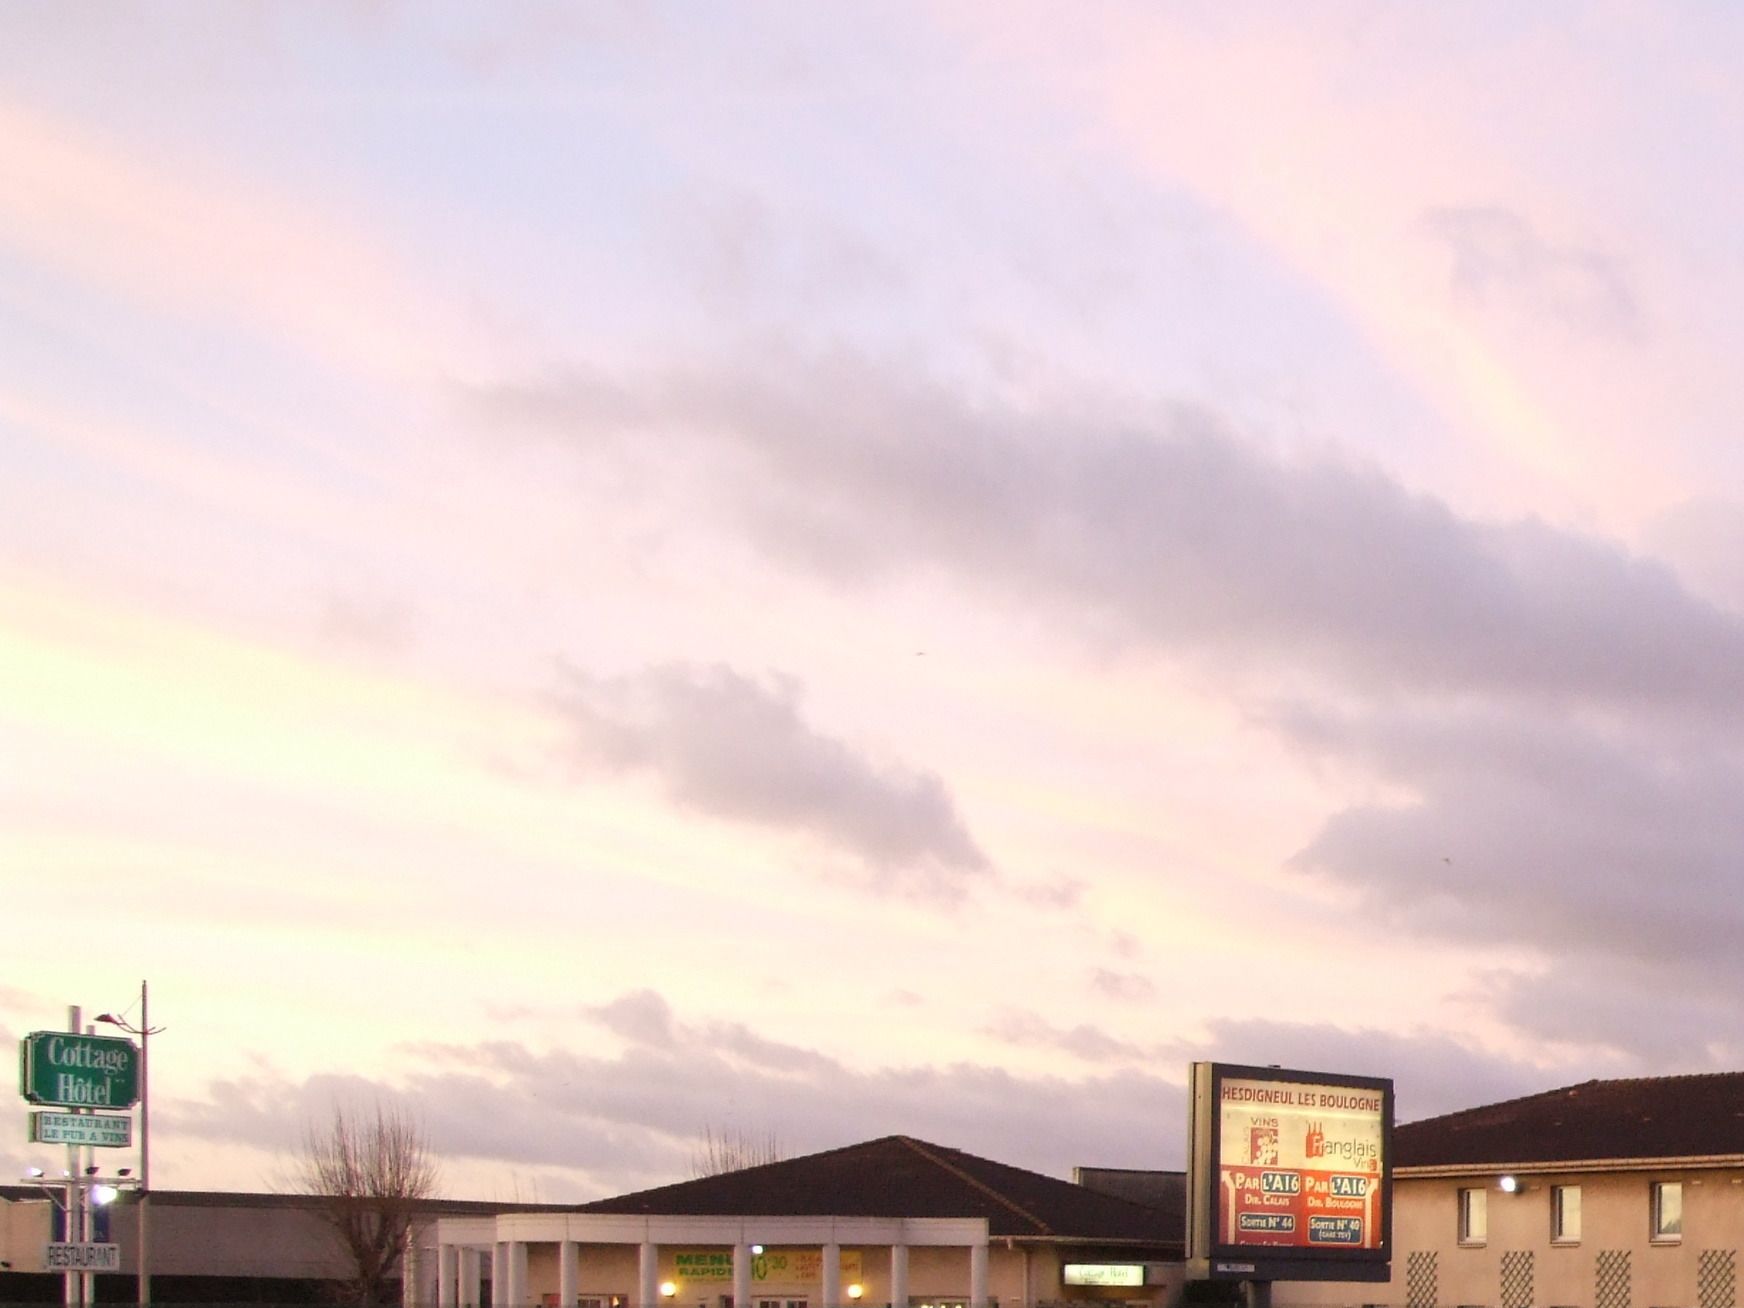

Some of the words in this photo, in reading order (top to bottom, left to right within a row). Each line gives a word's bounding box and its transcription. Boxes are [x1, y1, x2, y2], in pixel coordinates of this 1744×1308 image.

[48, 1037, 128, 1076] Cottage
[58, 1073, 112, 1105] Hôtel
[1222, 1087, 1294, 1105] HESDIGNEUL
[1298, 1094, 1316, 1106] LES
[1320, 1094, 1380, 1112] BOULOGNE
[44, 1116, 128, 1130] RESTAURANT
[1250, 1116, 1279, 1128] VINS
[44, 1129, 59, 1139] LE
[1311, 1134, 1377, 1160] Franglais
[48, 1246, 117, 1266] RESTAURANT
